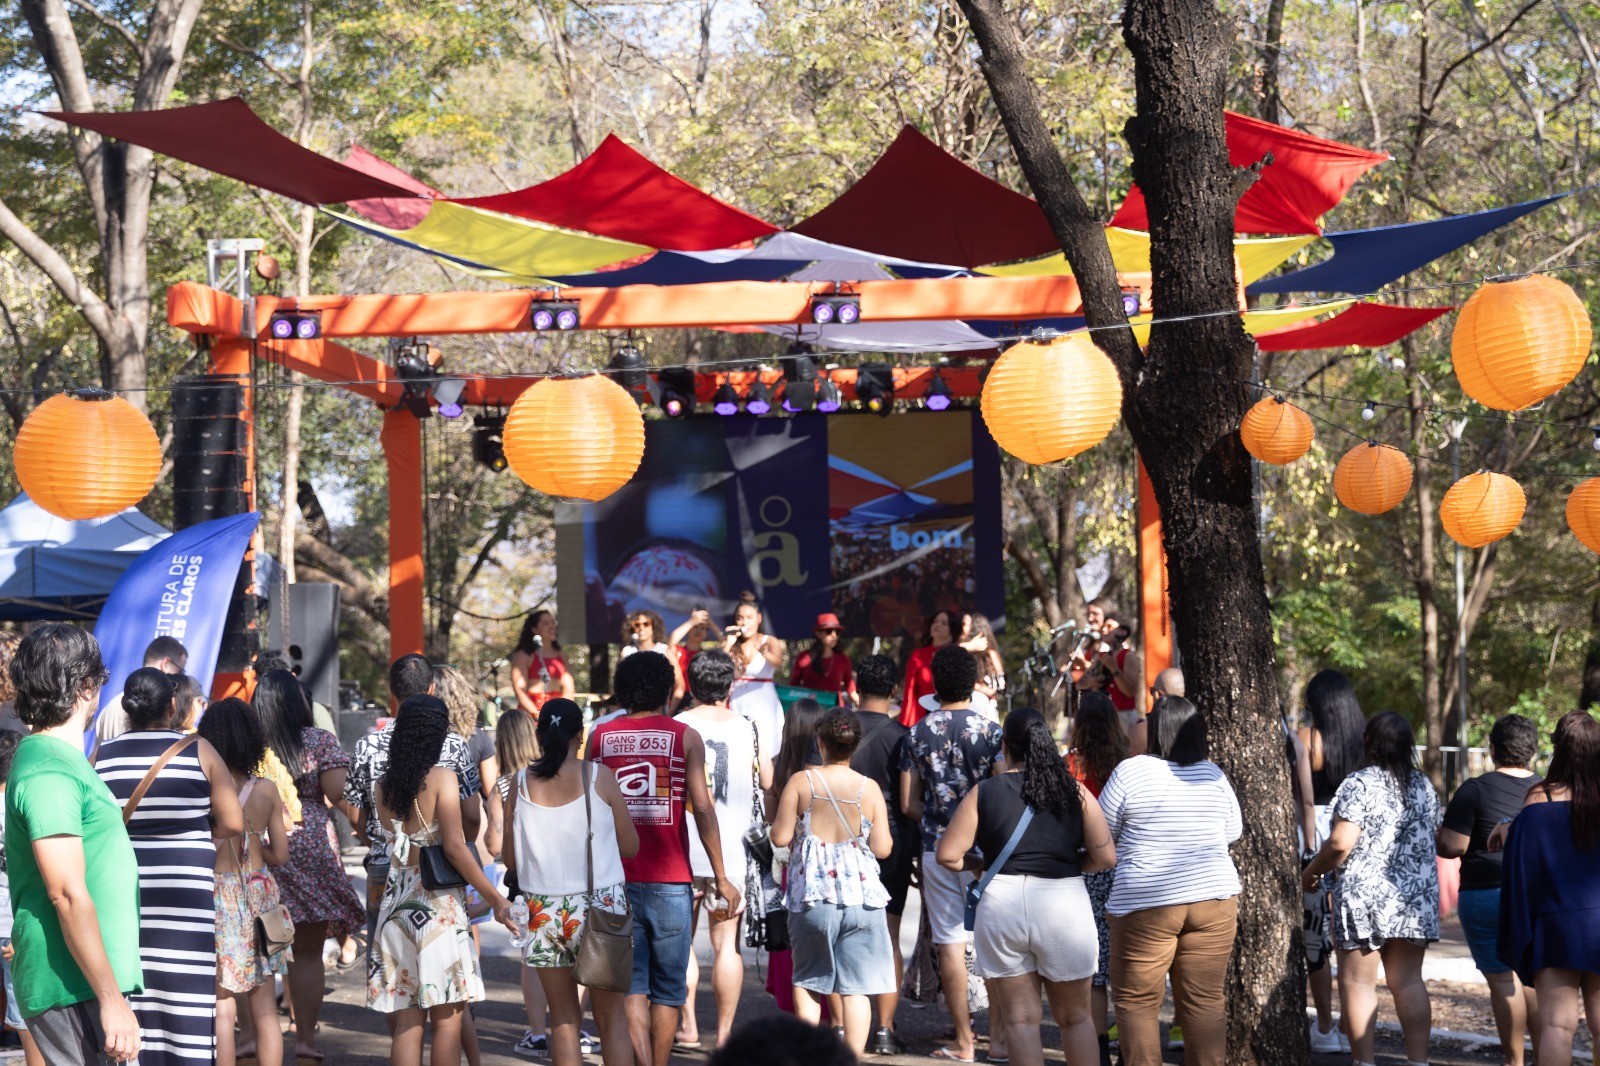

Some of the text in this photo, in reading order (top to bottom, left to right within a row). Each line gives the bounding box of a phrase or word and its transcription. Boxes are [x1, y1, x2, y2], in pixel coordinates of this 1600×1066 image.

[168, 555, 188, 576] DE
[175, 555, 203, 616] CLAROS
[606, 735, 636, 745] GANG
[612, 744, 636, 753] STER
